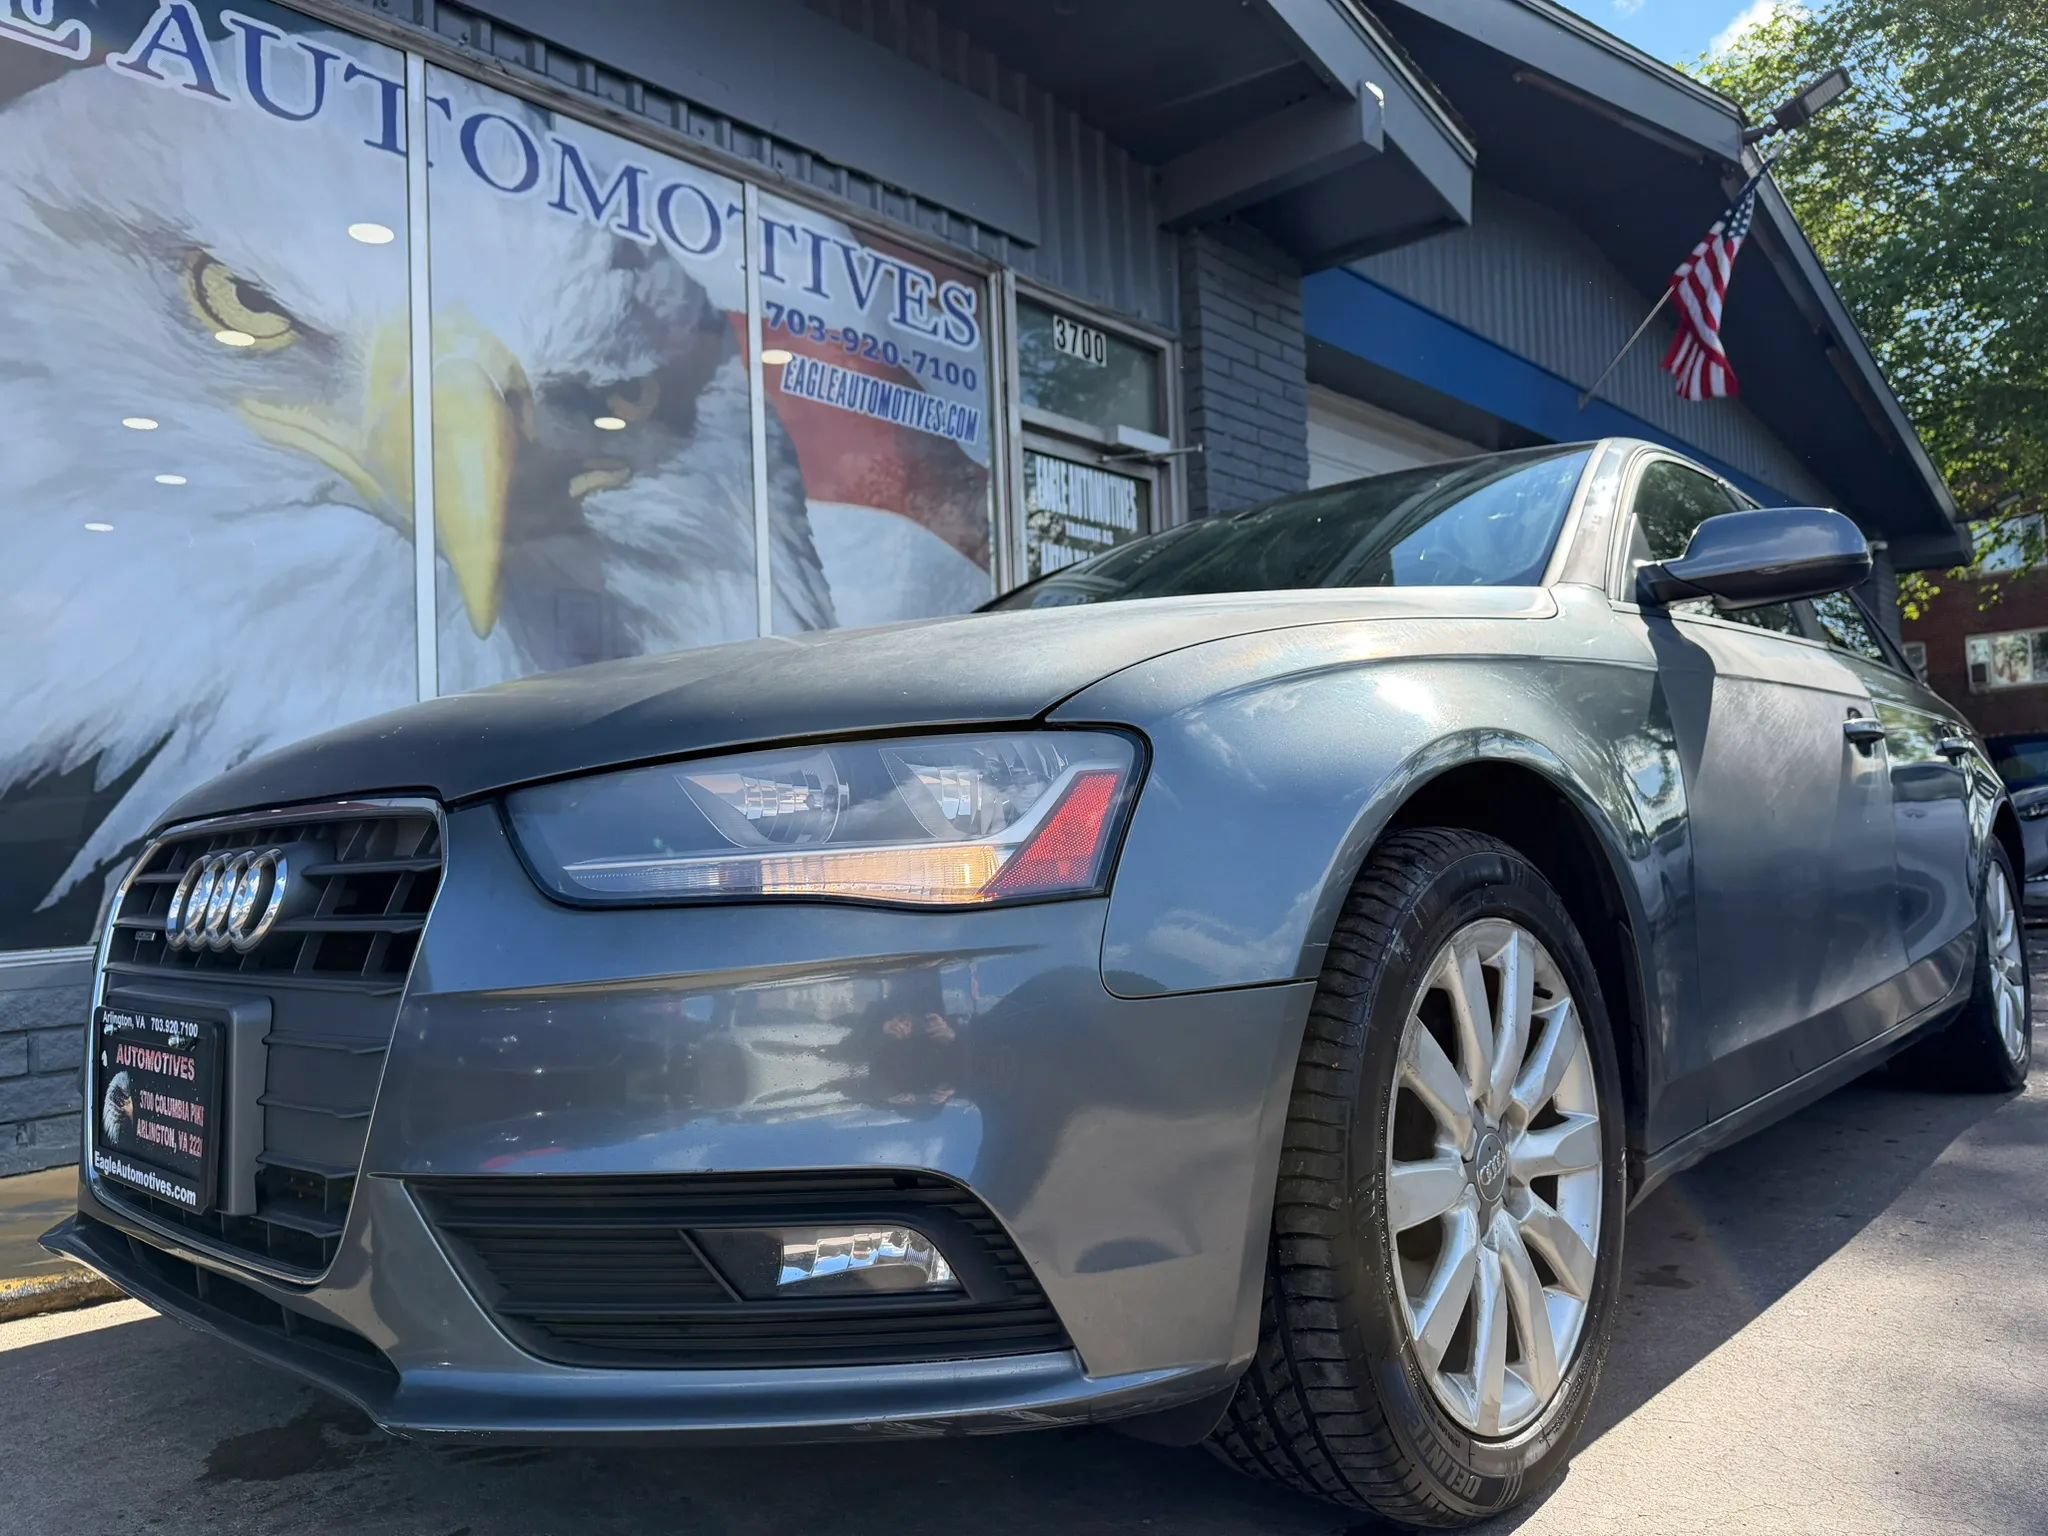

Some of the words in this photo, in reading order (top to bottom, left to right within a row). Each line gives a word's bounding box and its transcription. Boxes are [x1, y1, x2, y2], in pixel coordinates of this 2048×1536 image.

[114, 3, 976, 347] AUTOMOTIVES
[766, 302, 977, 391] 703-920-7100
[1056, 319, 1103, 363] 3700
[783, 356, 979, 442] EAGLEAUTOMOTIVES.COM
[102, 1010, 135, 1028] Arlington,
[135, 1014, 146, 1030] VA
[150, 1017, 199, 1037] 703.920.7100
[116, 1044, 195, 1081] AUTOMOTIVES
[94, 1150, 197, 1206] EagleAutomotives.com
